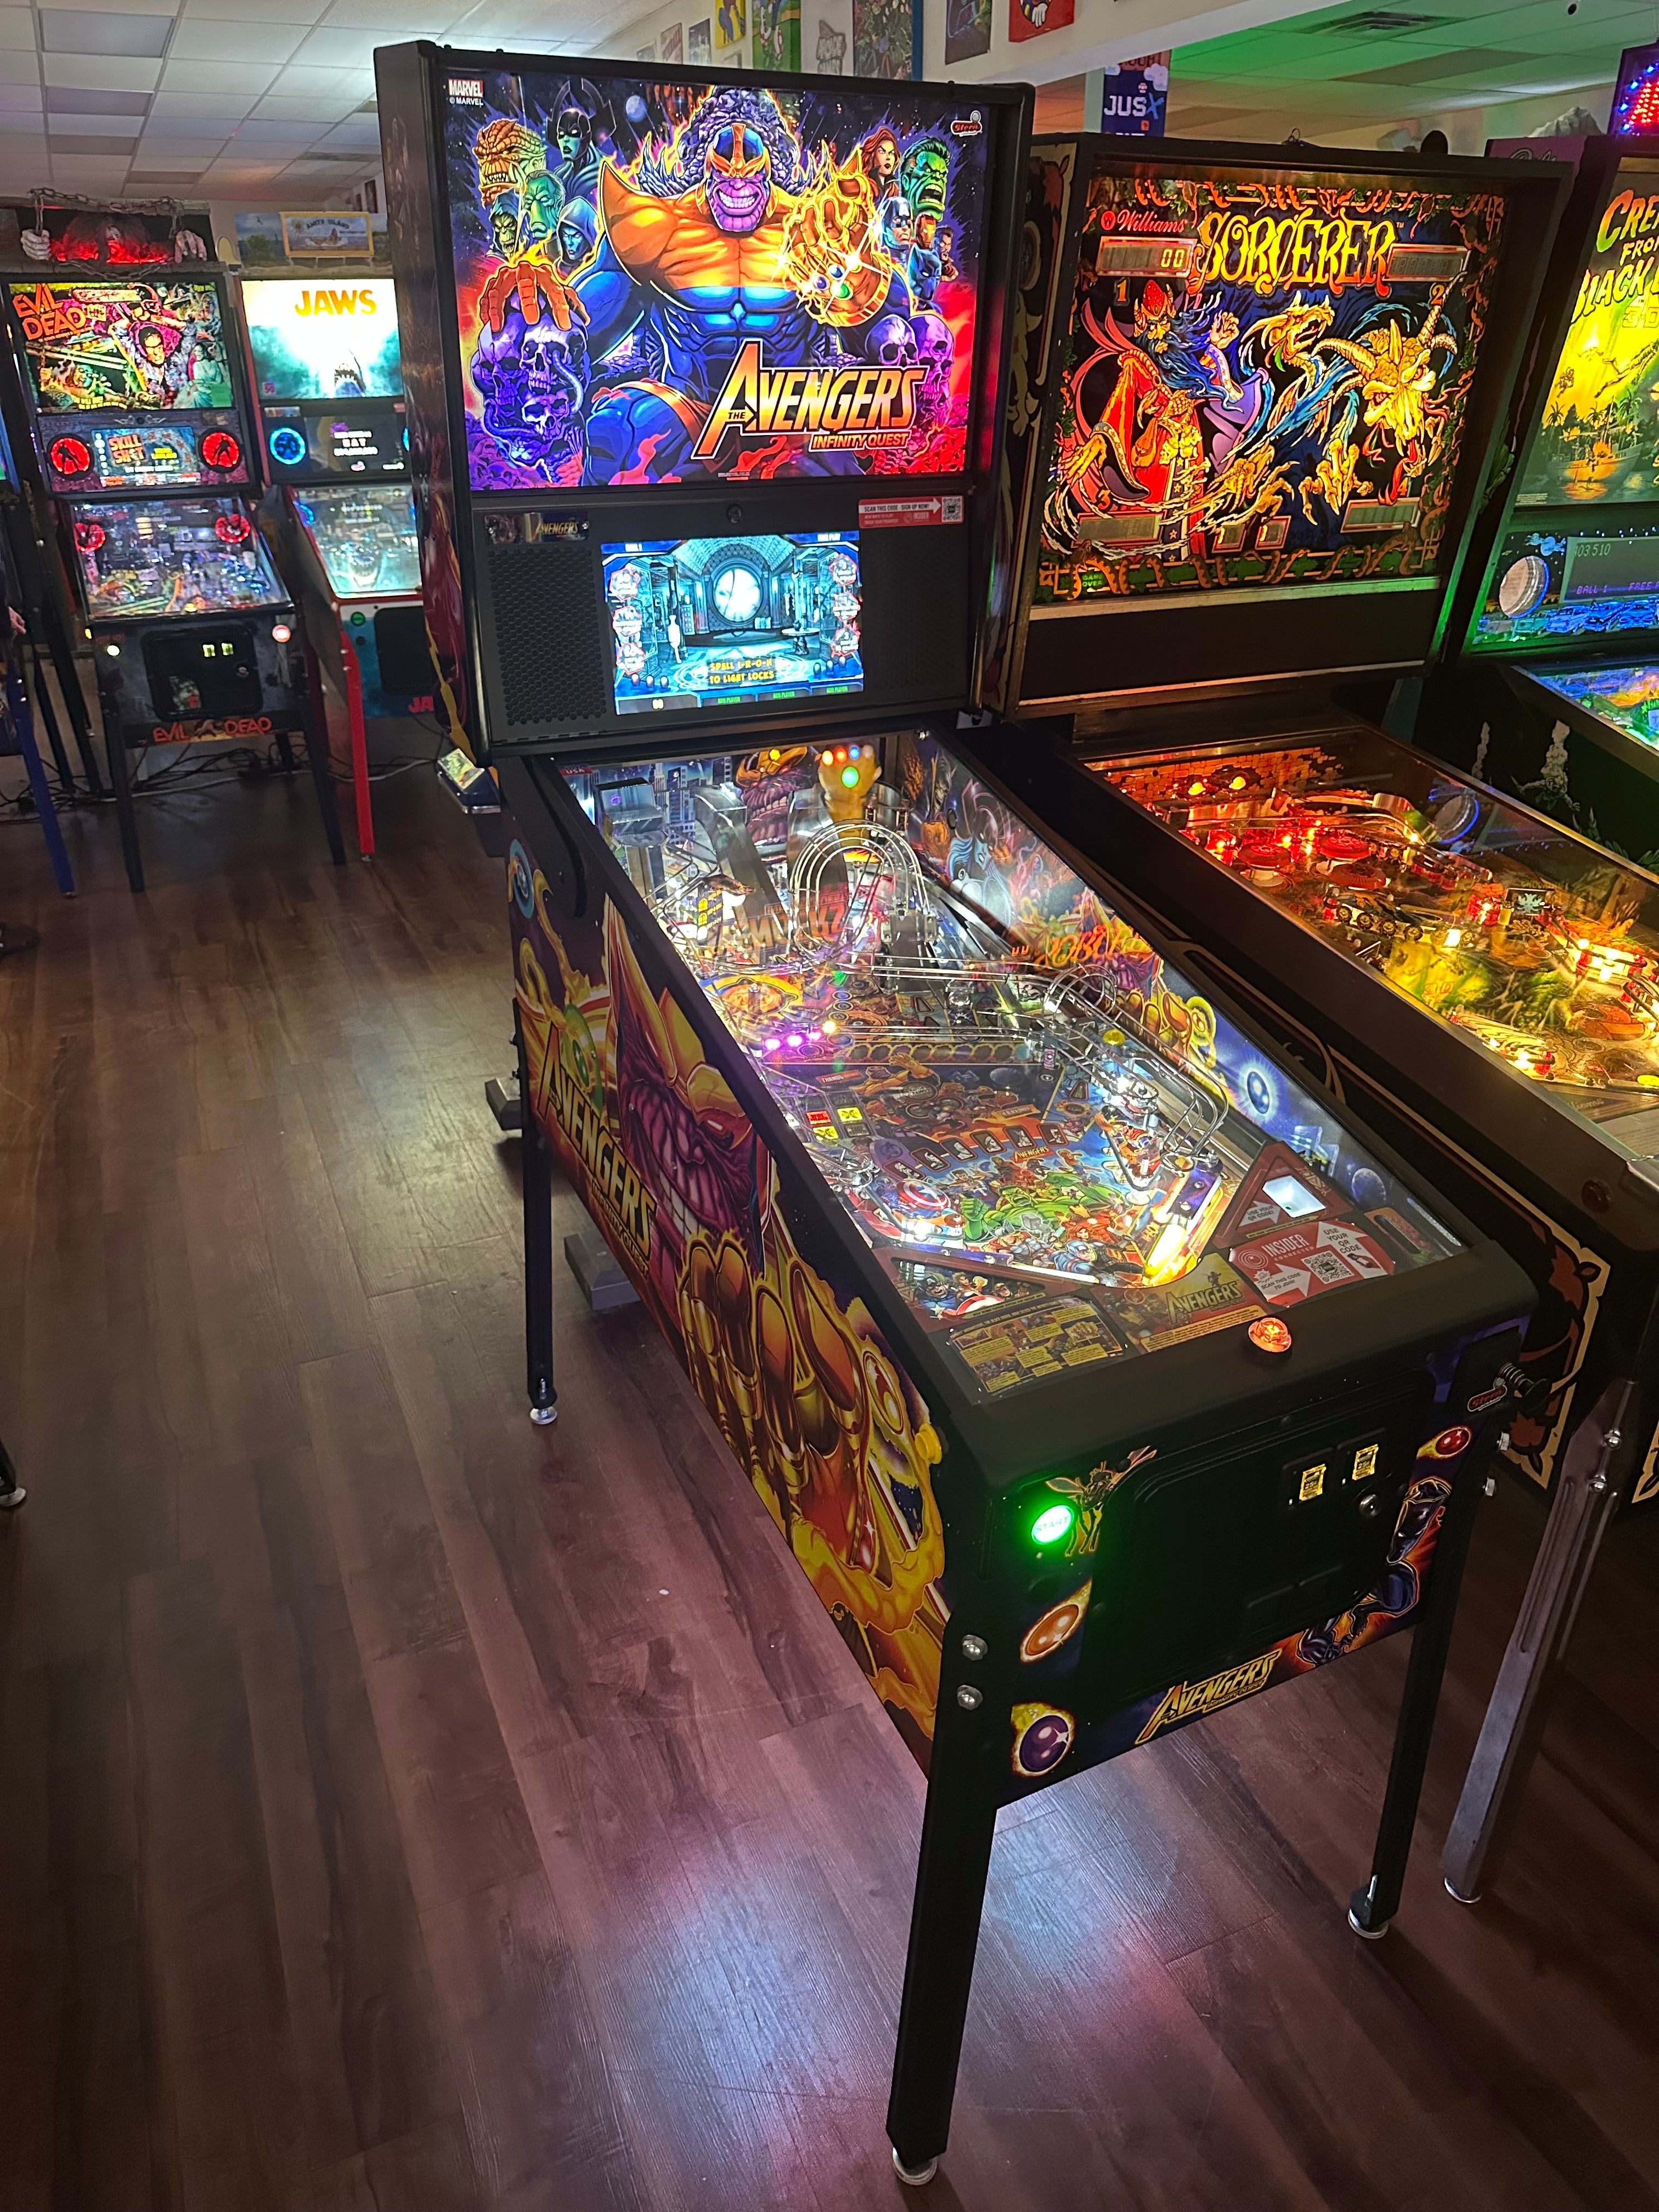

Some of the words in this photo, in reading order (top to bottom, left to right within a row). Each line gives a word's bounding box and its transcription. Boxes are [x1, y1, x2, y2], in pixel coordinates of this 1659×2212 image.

[449, 79, 483, 98] MARVEL
[456, 97, 483, 106] MARVEL
[1118, 209, 1188, 233] Williams
[1160, 249, 1185, 268] 00
[1188, 208, 1397, 296] SORCERER
[1117, 279, 1127, 302] 1
[1431, 284, 1444, 306] 2
[1571, 256, 1655, 323] BLACK
[13, 283, 64, 318] EVIL
[295, 289, 377, 317] JAWS
[22, 307, 87, 340] DEAD
[693, 339, 928, 458] AVENGERS
[727, 411, 746, 420] THE
[109, 434, 143, 451] SKILL
[812, 434, 866, 449] INFINITY
[867, 432, 908, 447] QUEST
[1397, 477, 1408, 496] 4
[1098, 489, 1111, 510] 3
[533, 518, 579, 540] AVENGERS
[1576, 585, 1598, 595] BALL
[1603, 584, 1607, 593] 1
[1628, 582, 1653, 590] FREE
[710, 662, 735, 672] SPELL
[709, 675, 720, 684] TO
[723, 673, 746, 684] LIGHT
[748, 670, 775, 681] LOCKS
[153, 723, 189, 743] EVIL
[224, 717, 272, 736] DEAD
[538, 1020, 657, 1262] AVENGERS
[1014, 1146, 1049, 1159] AVENGERS
[1259, 1205, 1274, 1214] YOUR
[1262, 1234, 1310, 1257] INSIDER
[1327, 1233, 1347, 1242] YOUR
[621, 1231, 649, 1281] QUEST
[1274, 1246, 1314, 1261] CONNECTED
[1340, 1244, 1361, 1254] CODE
[1261, 1280, 1276, 1290] SCAN
[1276, 1277, 1288, 1286] THIS
[1288, 1273, 1301, 1282] CODE
[1283, 1280, 1295, 1289] JOIN!
[1164, 1281, 1243, 1325] AVENGERS
[1036, 1516, 1069, 1532] START
[1136, 1649, 1282, 1744] AVENGERS
[1239, 1681, 1263, 1696] QUEST
